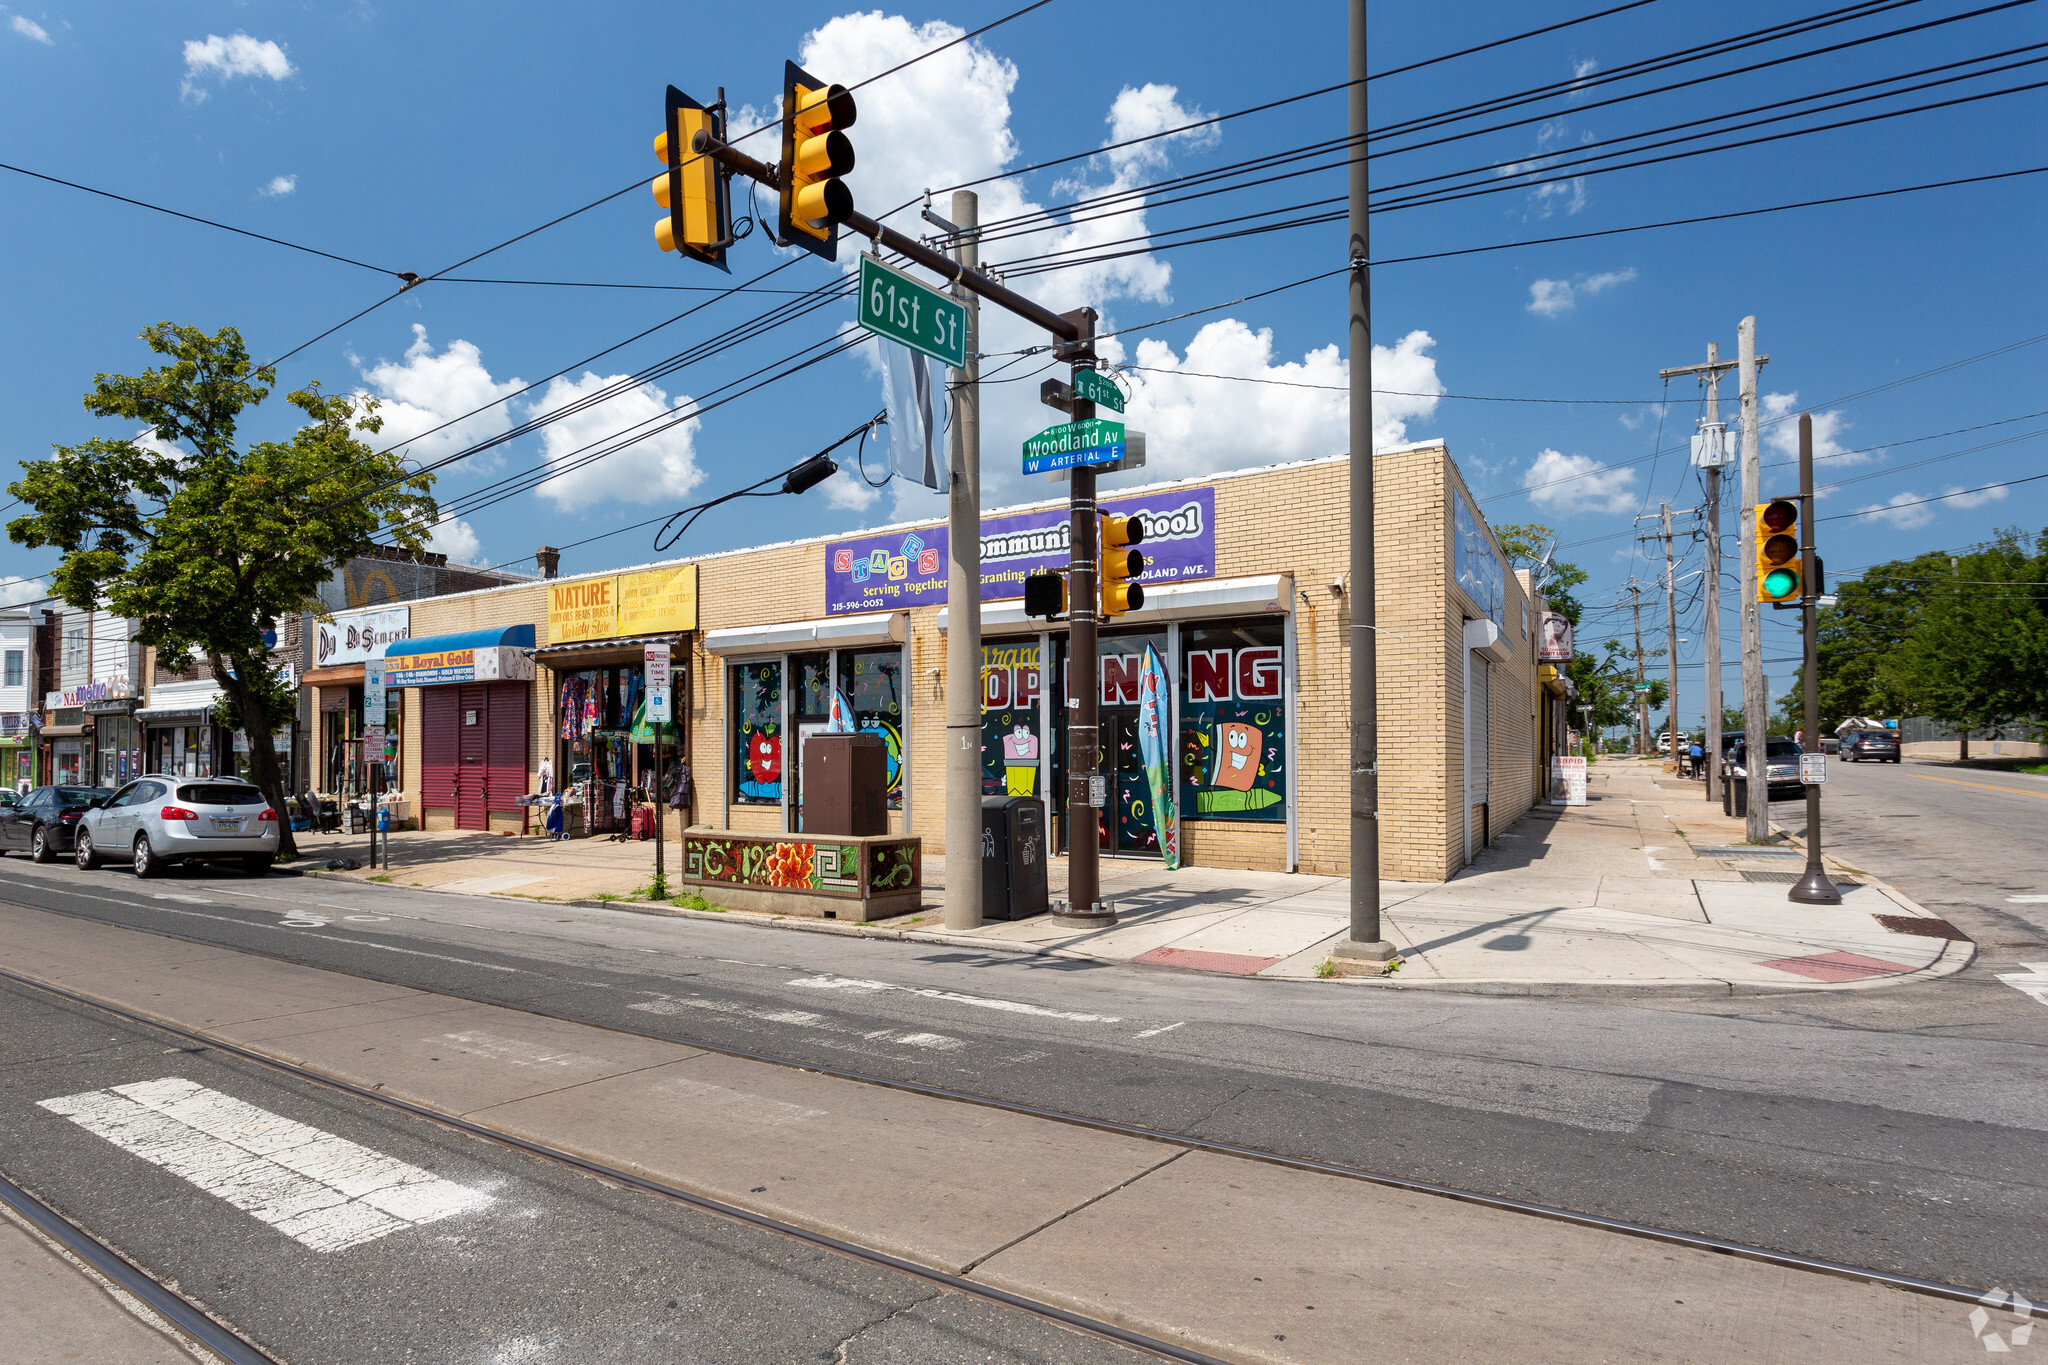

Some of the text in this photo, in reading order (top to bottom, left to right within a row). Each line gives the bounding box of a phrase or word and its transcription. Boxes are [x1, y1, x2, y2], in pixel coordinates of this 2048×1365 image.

[871, 277, 957, 351] 61st St
[1088, 382, 1123, 412] 61st St
[1050, 421, 1094, 435] 6100 W 6000
[1028, 428, 1118, 458] Woodland Av
[1028, 446, 1118, 472] W ARTERIAL E
[835, 535, 938, 580] STAGES
[1182, 564, 1208, 576] AVE.
[554, 580, 611, 611] NATURE
[863, 583, 900, 597] Serving
[903, 577, 948, 595] Together
[550, 613, 562, 623] BODY
[575, 609, 590, 621] BEADS
[592, 606, 609, 618] BRASS
[832, 598, 884, 611] 215-596-0052
[561, 619, 611, 640] Variety Store
[412, 653, 445, 670] Royal
[446, 650, 474, 666] Gold
[646, 652, 654, 660] NO
[365, 698, 371, 707] 2
